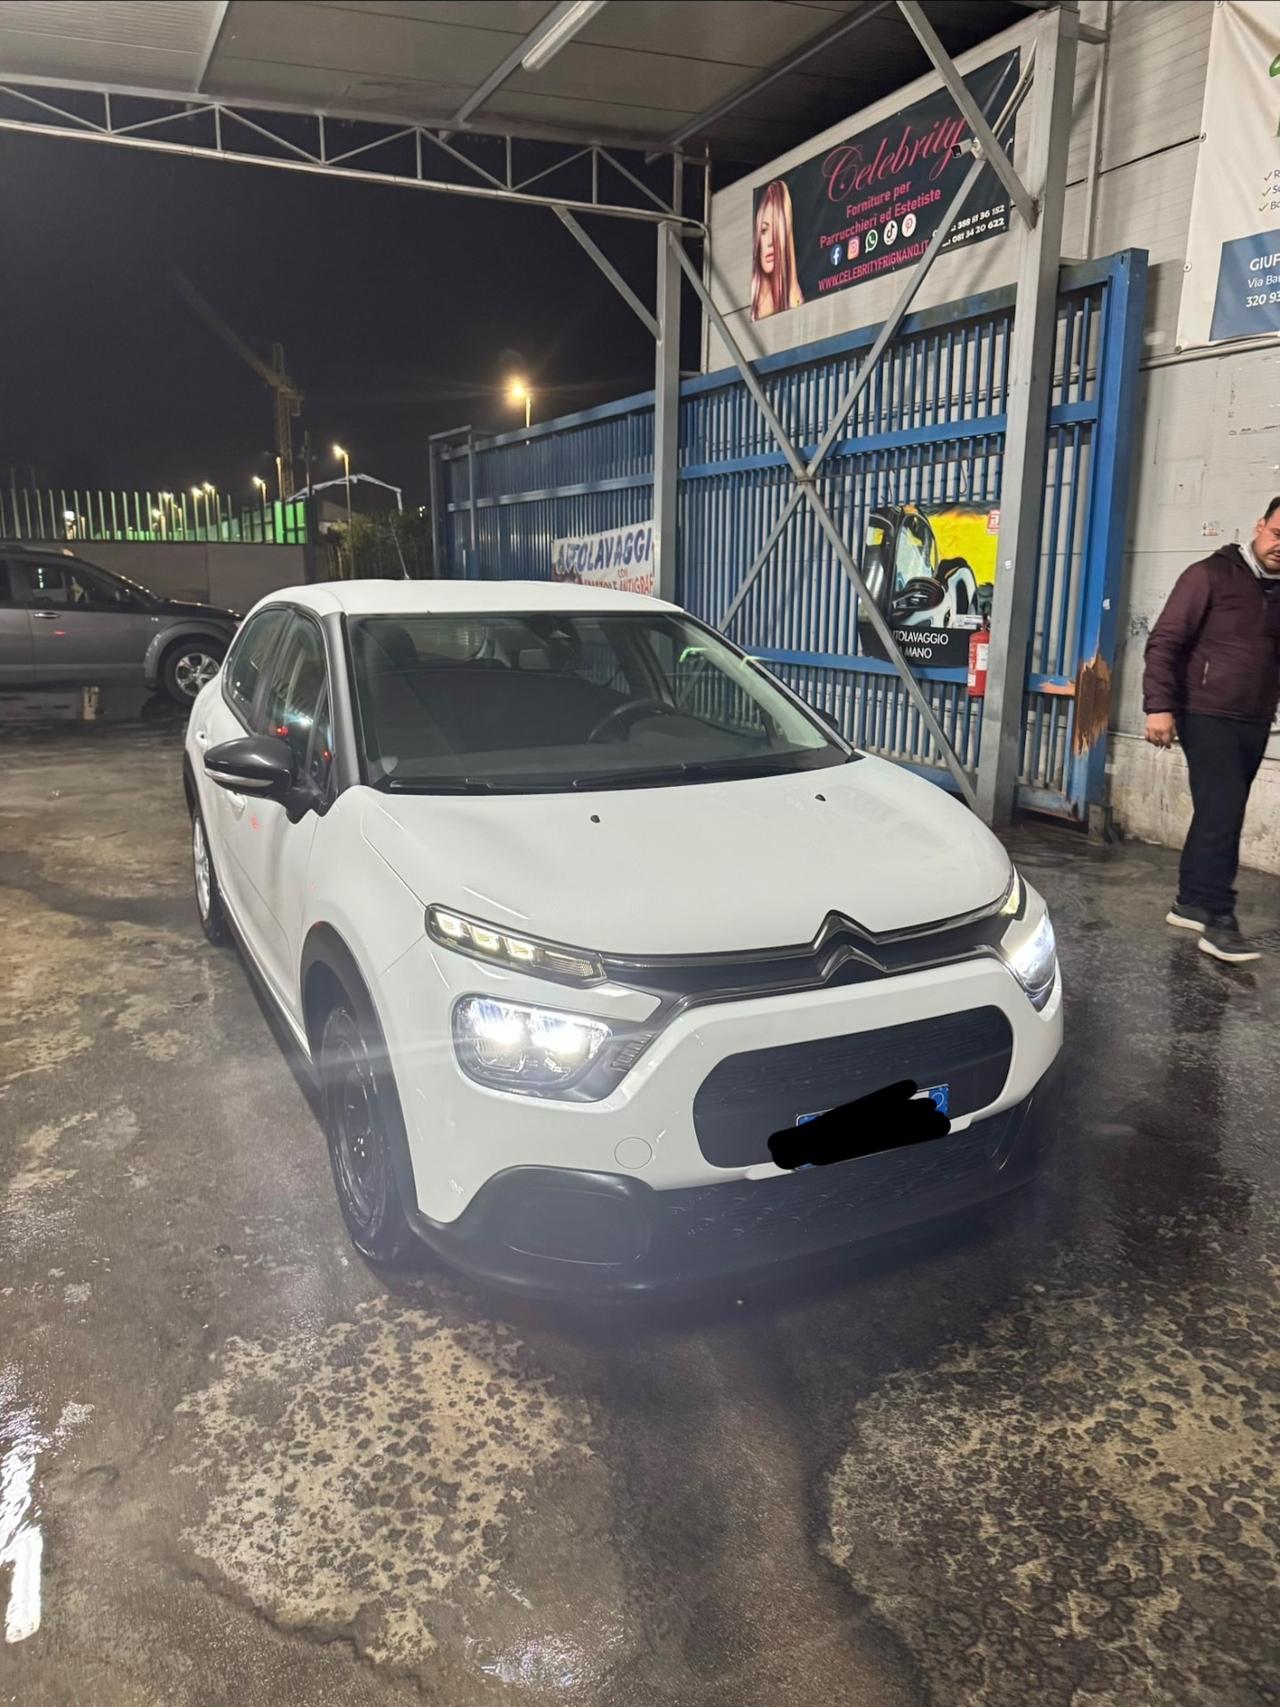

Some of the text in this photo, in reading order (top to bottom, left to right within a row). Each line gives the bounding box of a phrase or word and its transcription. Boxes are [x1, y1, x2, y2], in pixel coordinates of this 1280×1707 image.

[821, 117, 966, 202] Celebrity
[846, 181, 912, 218] Forniture per
[820, 189, 942, 248] Parrucchieri ed Estetiste
[975, 223, 986, 234] 20
[987, 217, 1005, 230] 622
[1247, 277, 1264, 289] Via
[1245, 293, 1267, 308] 320
[904, 646, 933, 659] MANO
